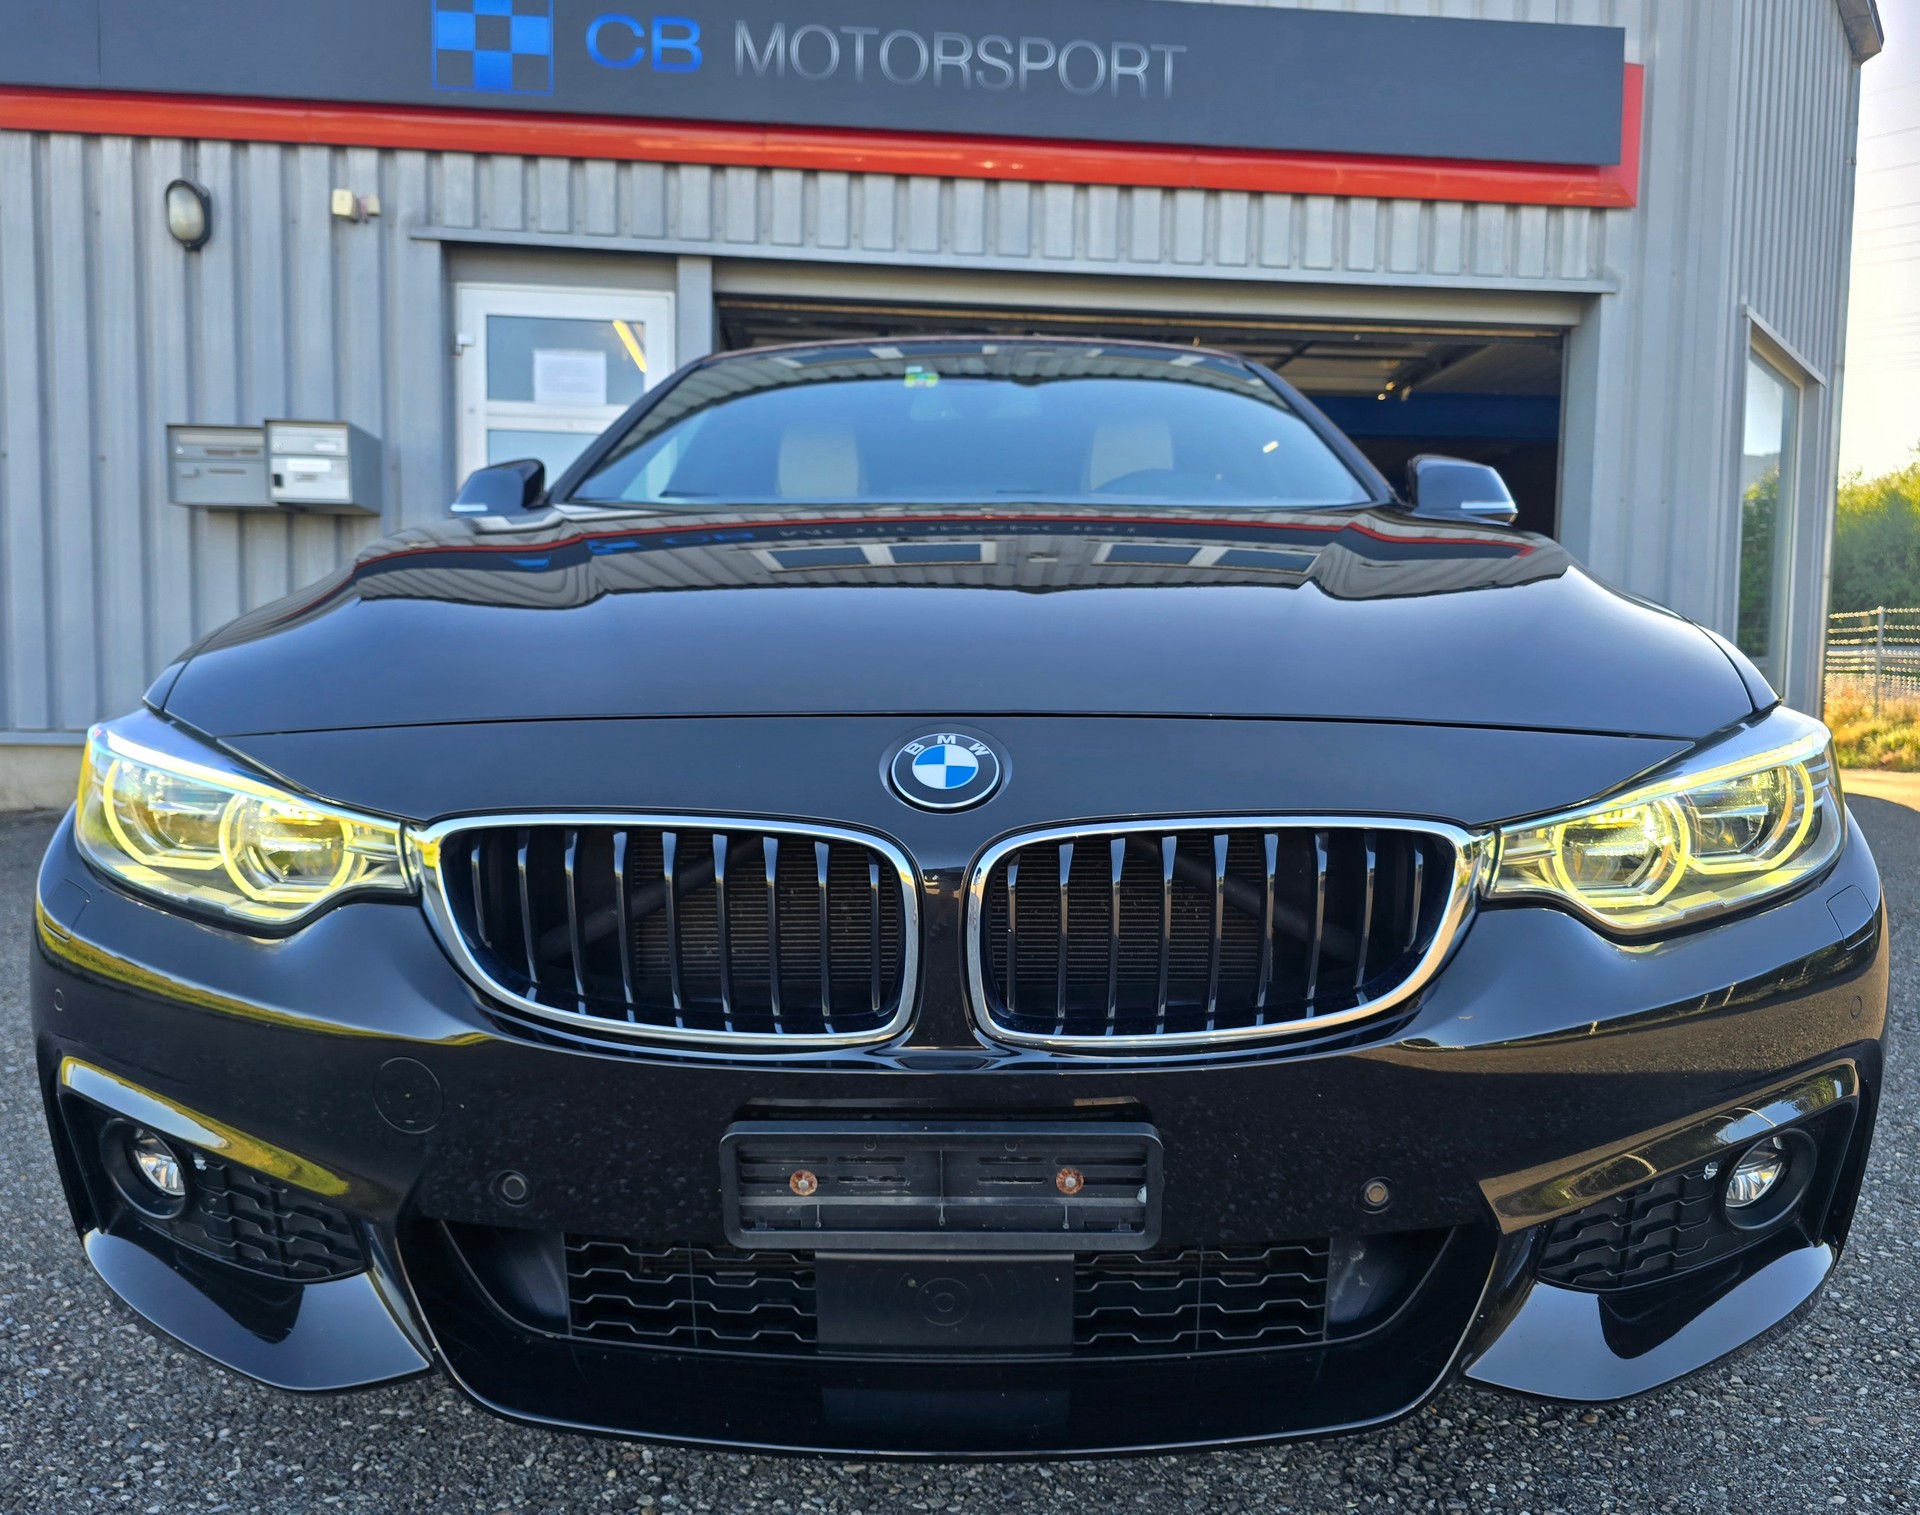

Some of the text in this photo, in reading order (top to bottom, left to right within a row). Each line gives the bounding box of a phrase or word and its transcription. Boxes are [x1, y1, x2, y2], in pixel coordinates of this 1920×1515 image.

[585, 12, 1187, 99] CB MOTORSPORT
[904, 735, 990, 756] BMW
